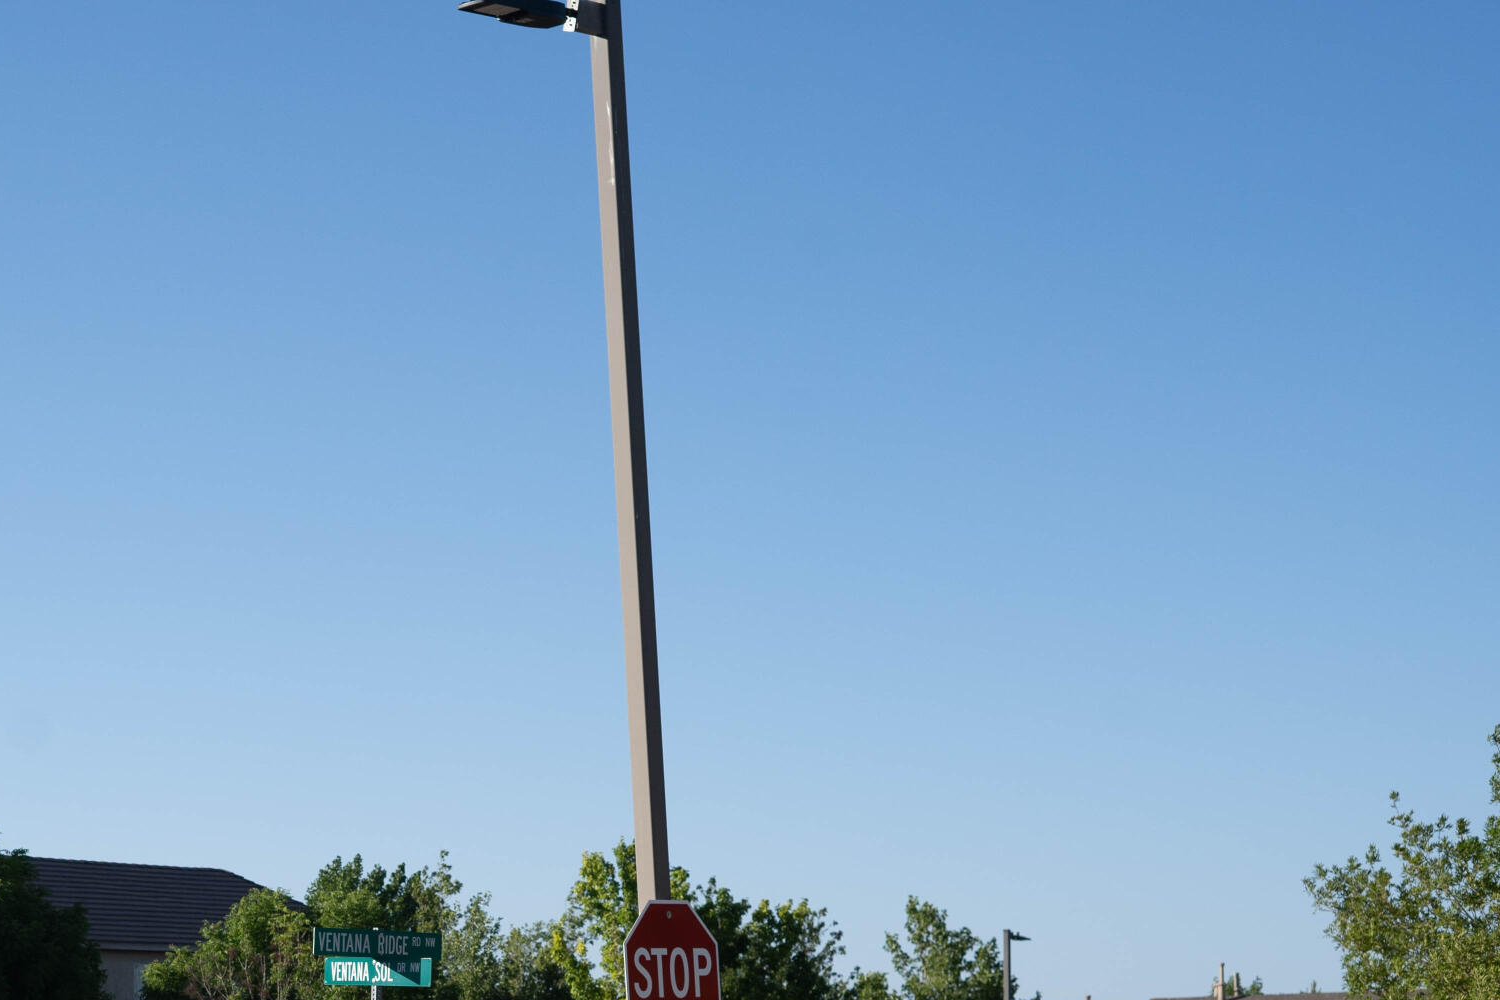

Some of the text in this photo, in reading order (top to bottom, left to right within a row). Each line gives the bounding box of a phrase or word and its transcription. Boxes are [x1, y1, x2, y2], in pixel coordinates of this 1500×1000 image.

[318, 932, 436, 956] VENTANA RIDGE RD NW
[330, 961, 420, 982] VENTANA SOL DR NW
[633, 947, 712, 998] STOP
